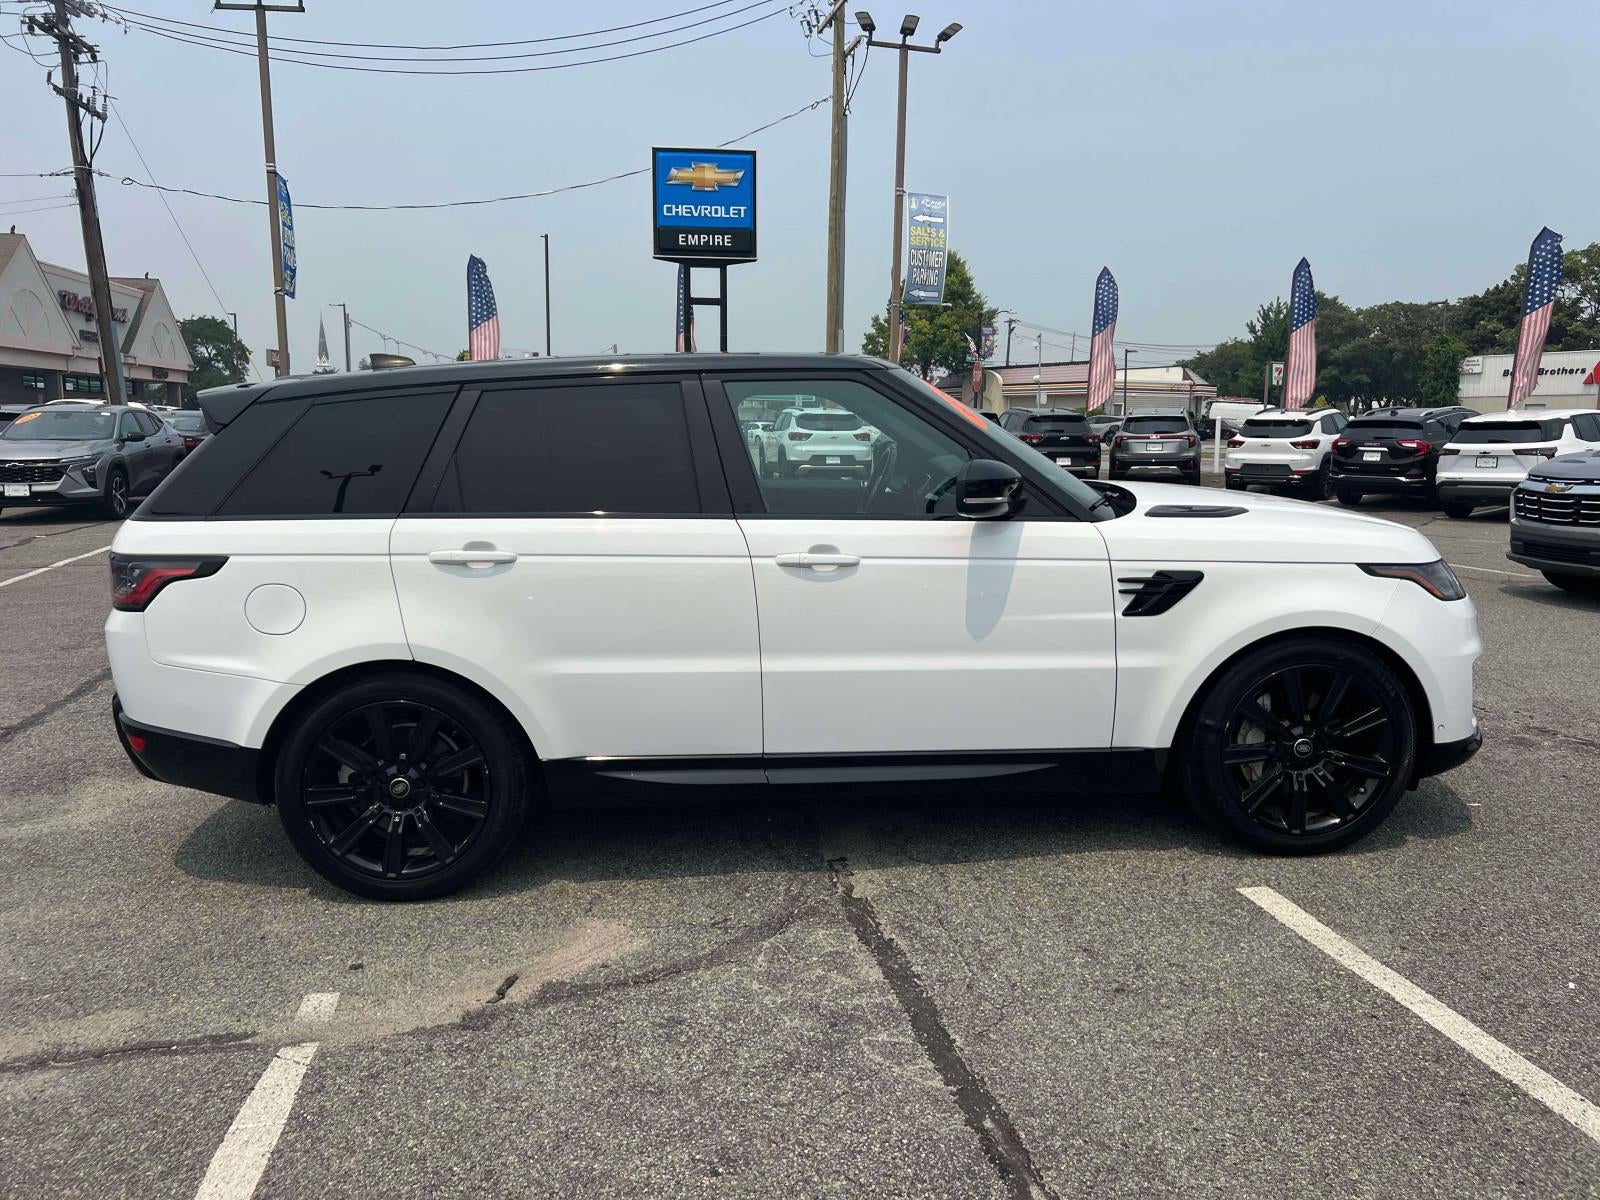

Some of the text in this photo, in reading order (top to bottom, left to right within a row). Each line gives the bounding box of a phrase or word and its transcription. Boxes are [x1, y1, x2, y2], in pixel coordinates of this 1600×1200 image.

[663, 204, 748, 219] CHEVROLET
[938, 228, 945, 238] &
[678, 233, 732, 246] EMPIRE
[1537, 366, 1587, 376] Brothers
